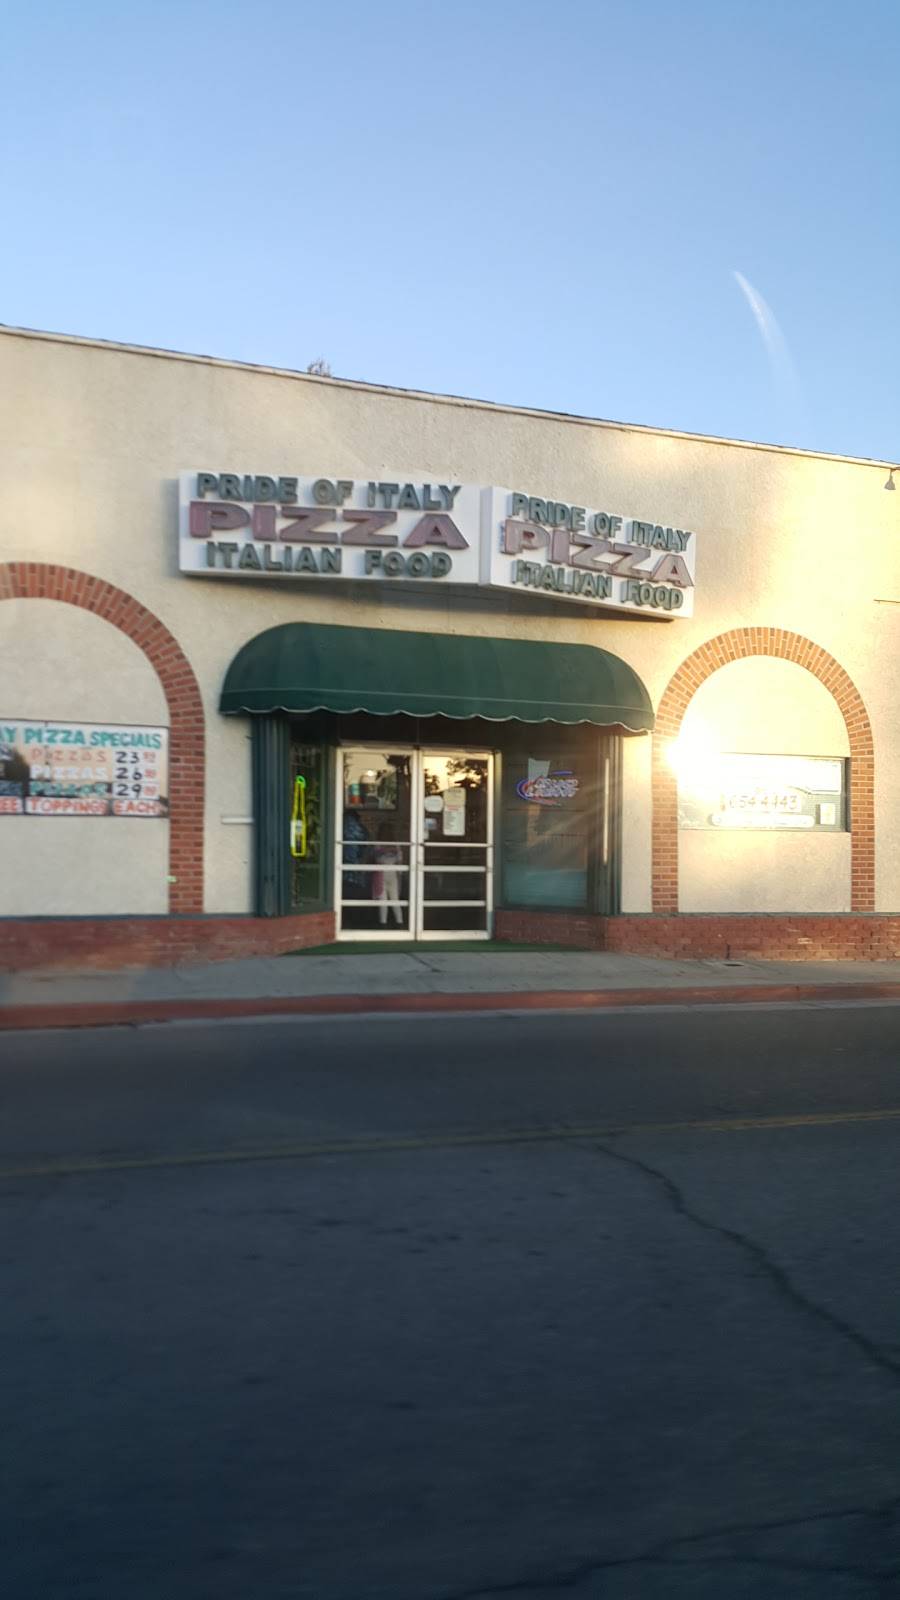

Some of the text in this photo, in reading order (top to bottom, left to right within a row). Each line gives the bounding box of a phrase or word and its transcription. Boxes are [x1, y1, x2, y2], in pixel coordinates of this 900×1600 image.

[197, 472, 462, 511] PRIDE OF ITALY
[189, 500, 470, 550] PIZZA
[509, 492, 692, 551] PRIDE OF ITALY
[206, 541, 452, 577] ITALIAN FOOD
[502, 519, 694, 588] PIZZA
[512, 560, 683, 610] ITALIAN FOOD
[24, 727, 86, 744] PIZZA
[90, 731, 162, 750] SPECIALS
[115, 751, 141, 764] 23
[115, 767, 142, 780] 26
[31, 799, 107, 815] TOPPINGS
[116, 784, 142, 799] 29
